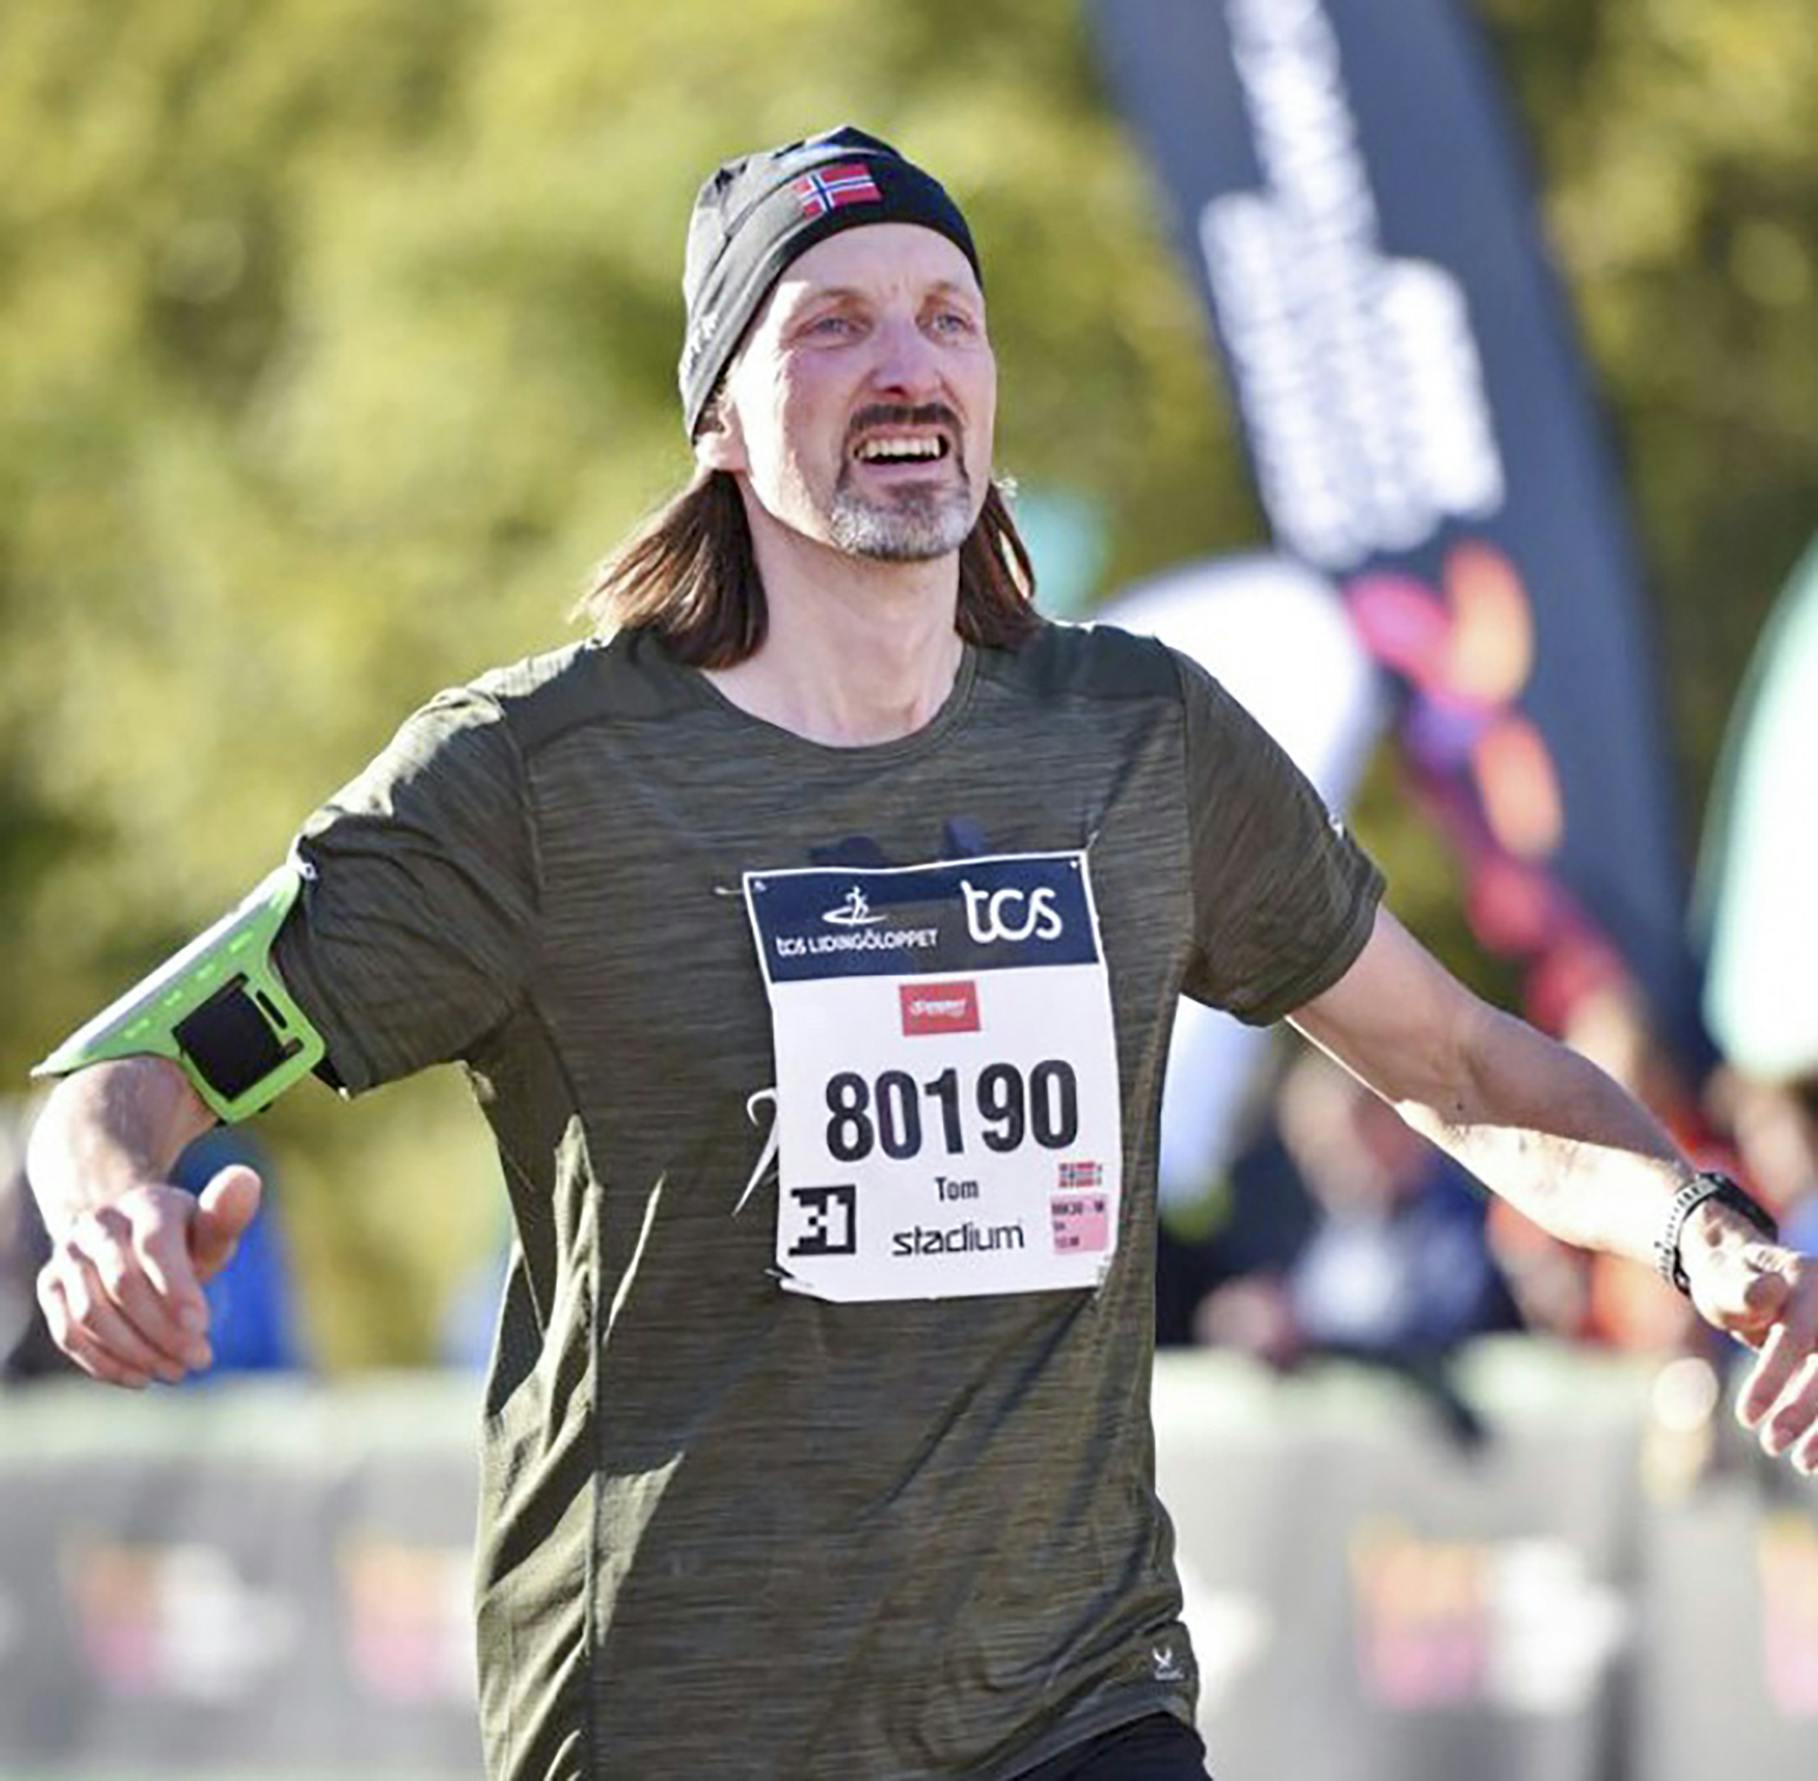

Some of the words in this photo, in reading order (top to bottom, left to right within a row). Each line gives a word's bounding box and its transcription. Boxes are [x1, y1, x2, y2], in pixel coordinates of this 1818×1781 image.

[961, 880, 1062, 943] tcs
[775, 936, 807, 957] tcs
[826, 1060, 1078, 1162] 80190
[934, 1177, 979, 1201] Tom
[892, 1222, 1024, 1256] stadium
